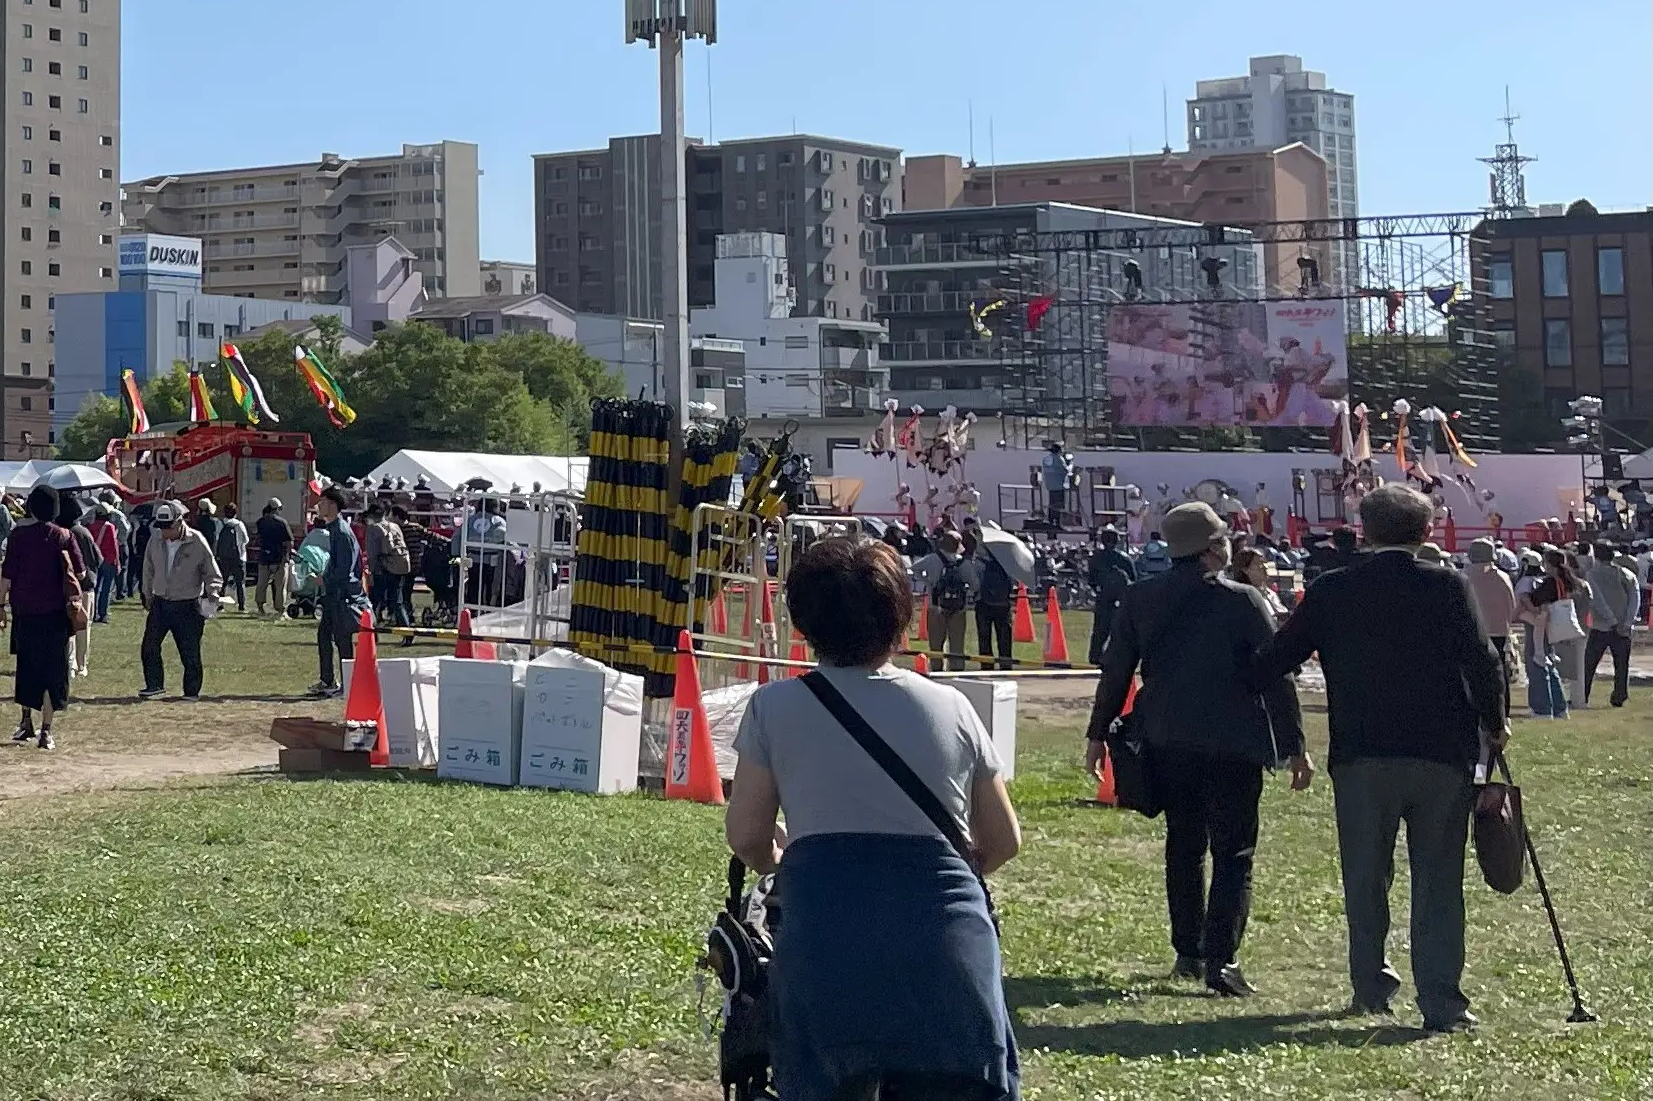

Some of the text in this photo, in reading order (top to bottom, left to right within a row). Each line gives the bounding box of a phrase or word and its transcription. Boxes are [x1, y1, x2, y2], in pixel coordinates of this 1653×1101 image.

[150, 246, 199, 266] DUSKIN
[447, 746, 500, 767] ごみ箱
[530, 753, 589, 775] ごみ箱
